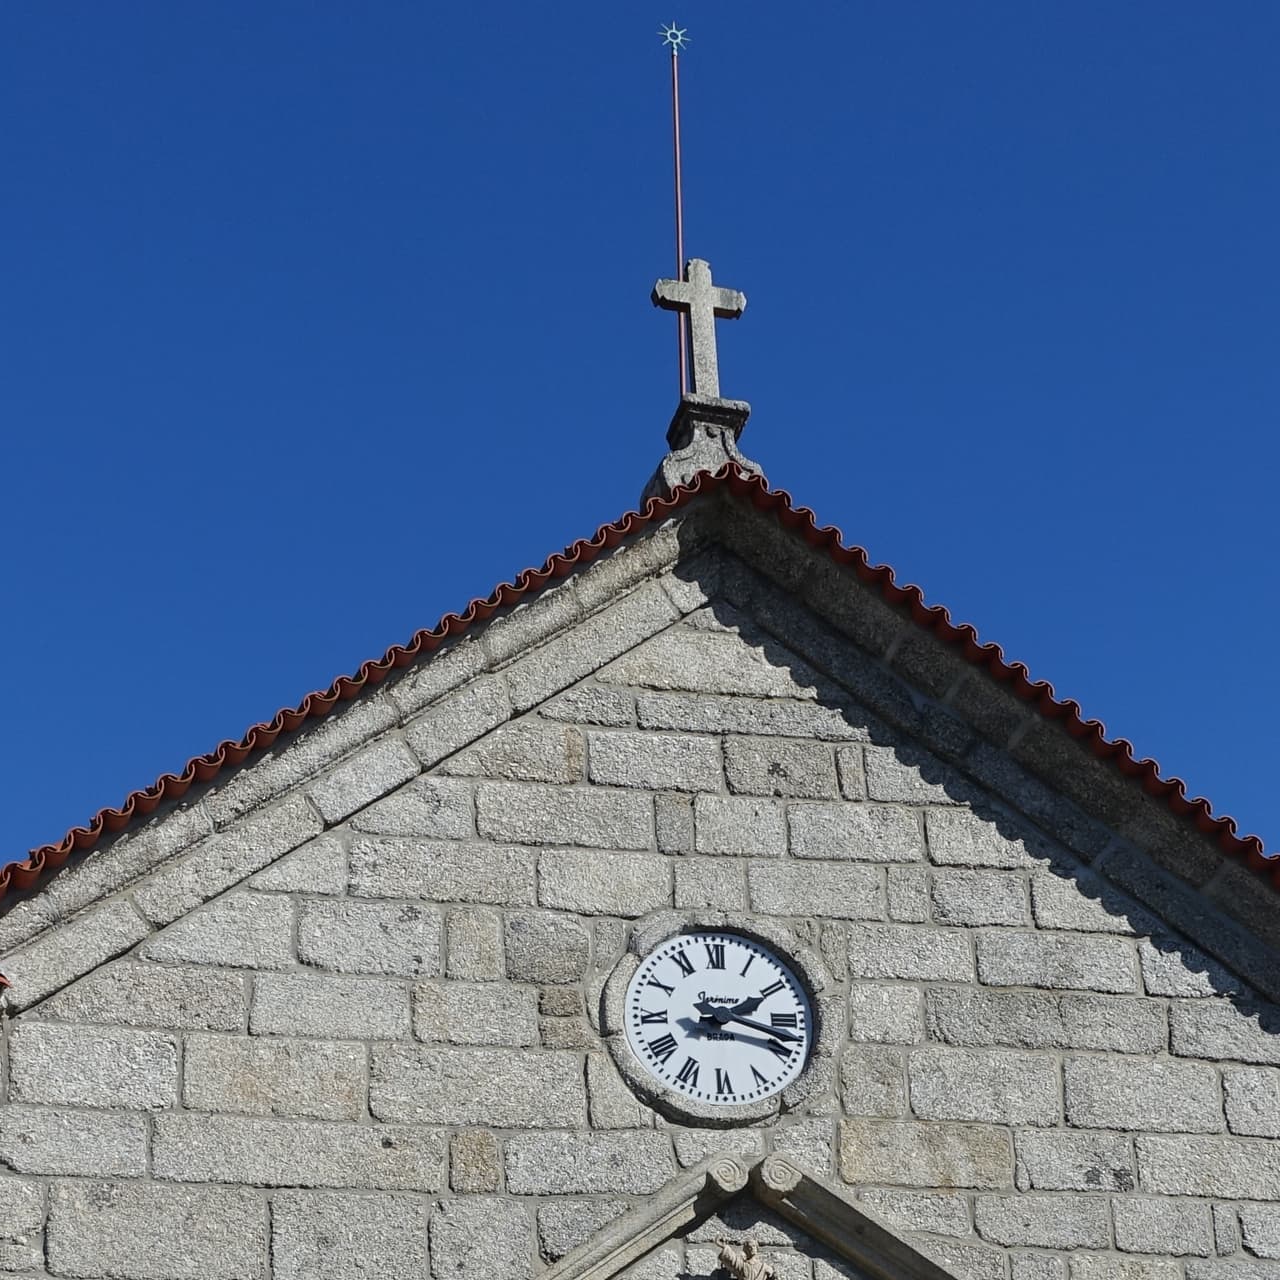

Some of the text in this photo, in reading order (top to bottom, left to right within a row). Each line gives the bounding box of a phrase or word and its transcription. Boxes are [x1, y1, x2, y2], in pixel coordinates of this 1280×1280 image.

[670, 949, 697, 979] XI
[705, 943, 726, 970] XII
[739, 954, 756, 978] I
[646, 973, 676, 997] X
[760, 979, 787, 1000] II
[640, 1008, 669, 1025] IX
[770, 1012, 798, 1029] III
[648, 1032, 679, 1066] VIII
[676, 1055, 701, 1089] VII
[715, 1067, 736, 1095] VI
[750, 1064, 770, 1088] V
